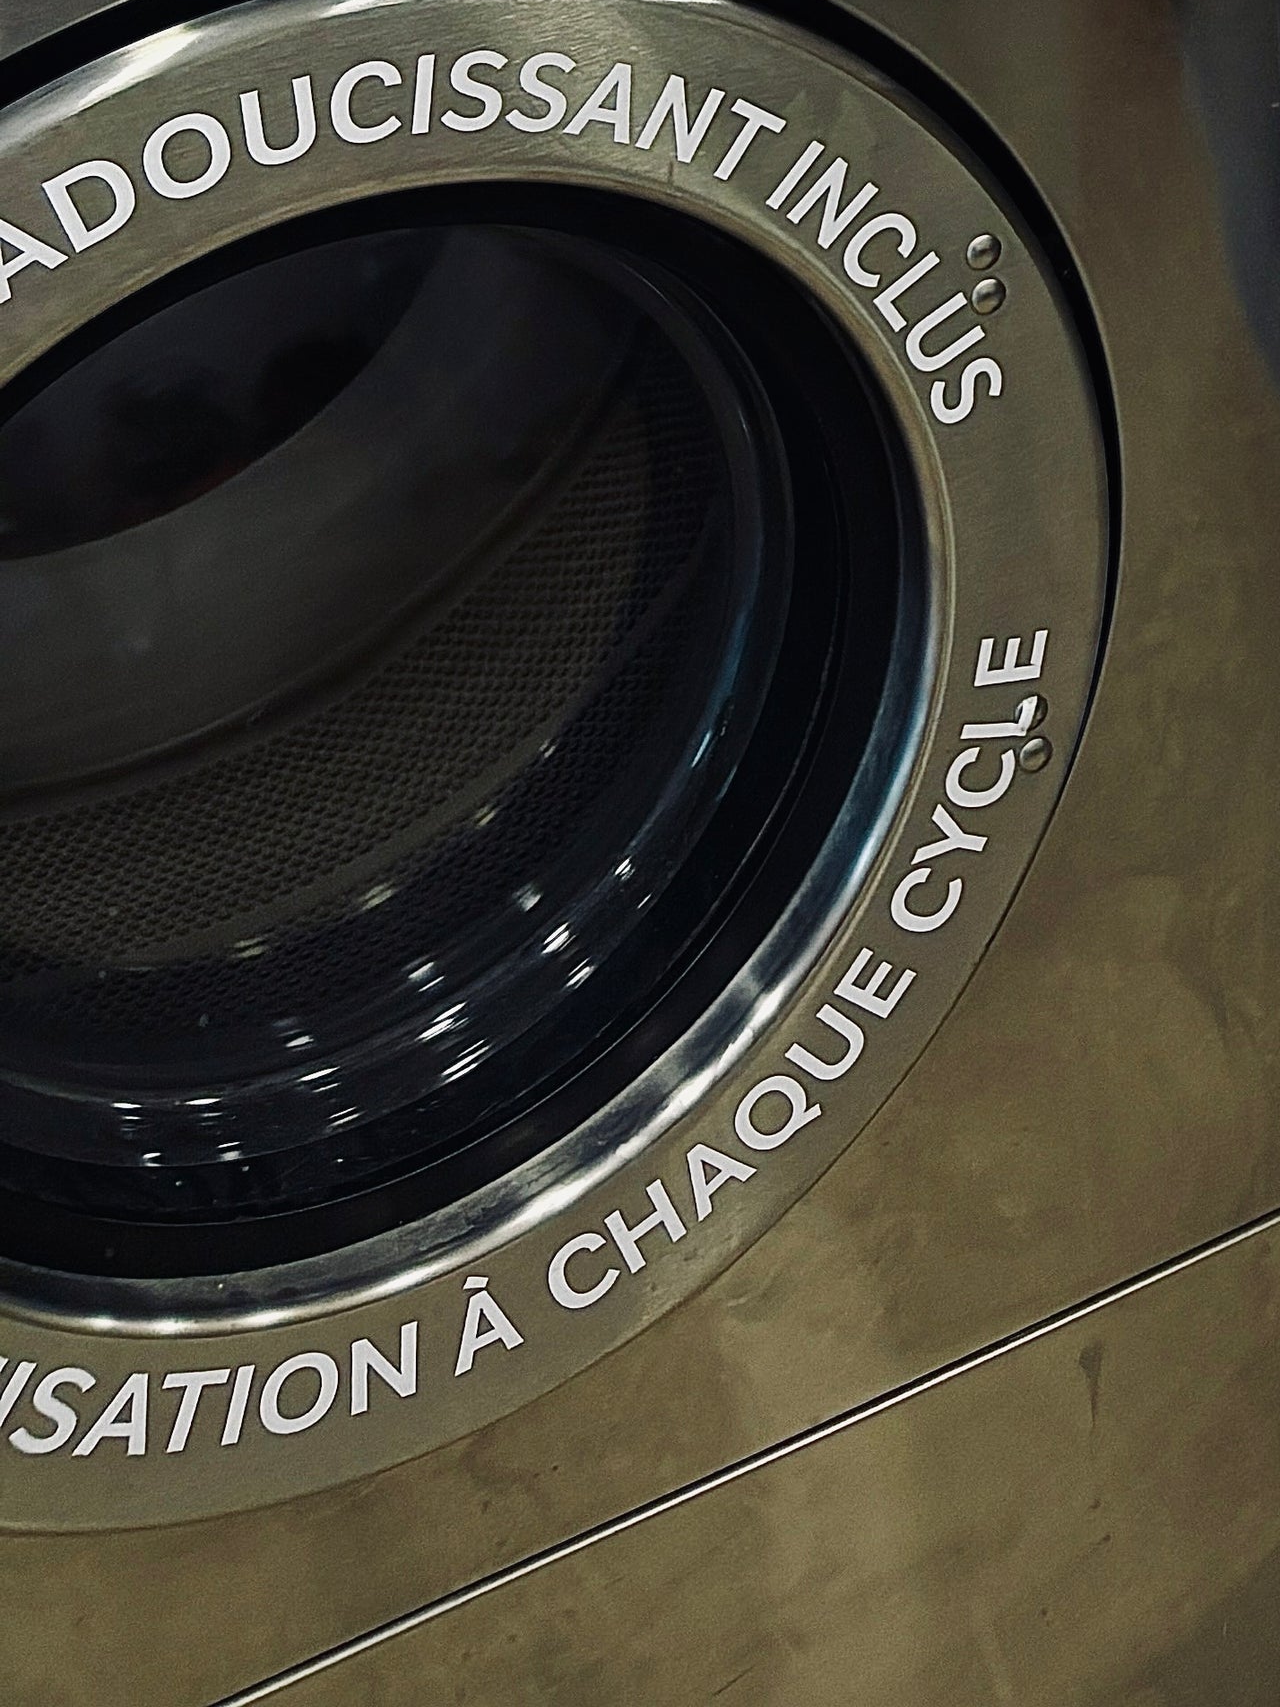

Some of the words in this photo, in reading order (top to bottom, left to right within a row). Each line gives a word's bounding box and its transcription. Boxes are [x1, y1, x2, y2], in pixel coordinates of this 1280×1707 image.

[765, 140, 1003, 425] INCLUS
[0, 1321, 418, 1457] ISATION
[455, 1276, 524, 1378] À
[547, 947, 918, 1310] CHAQUE
[889, 628, 1049, 933] CYCLE
